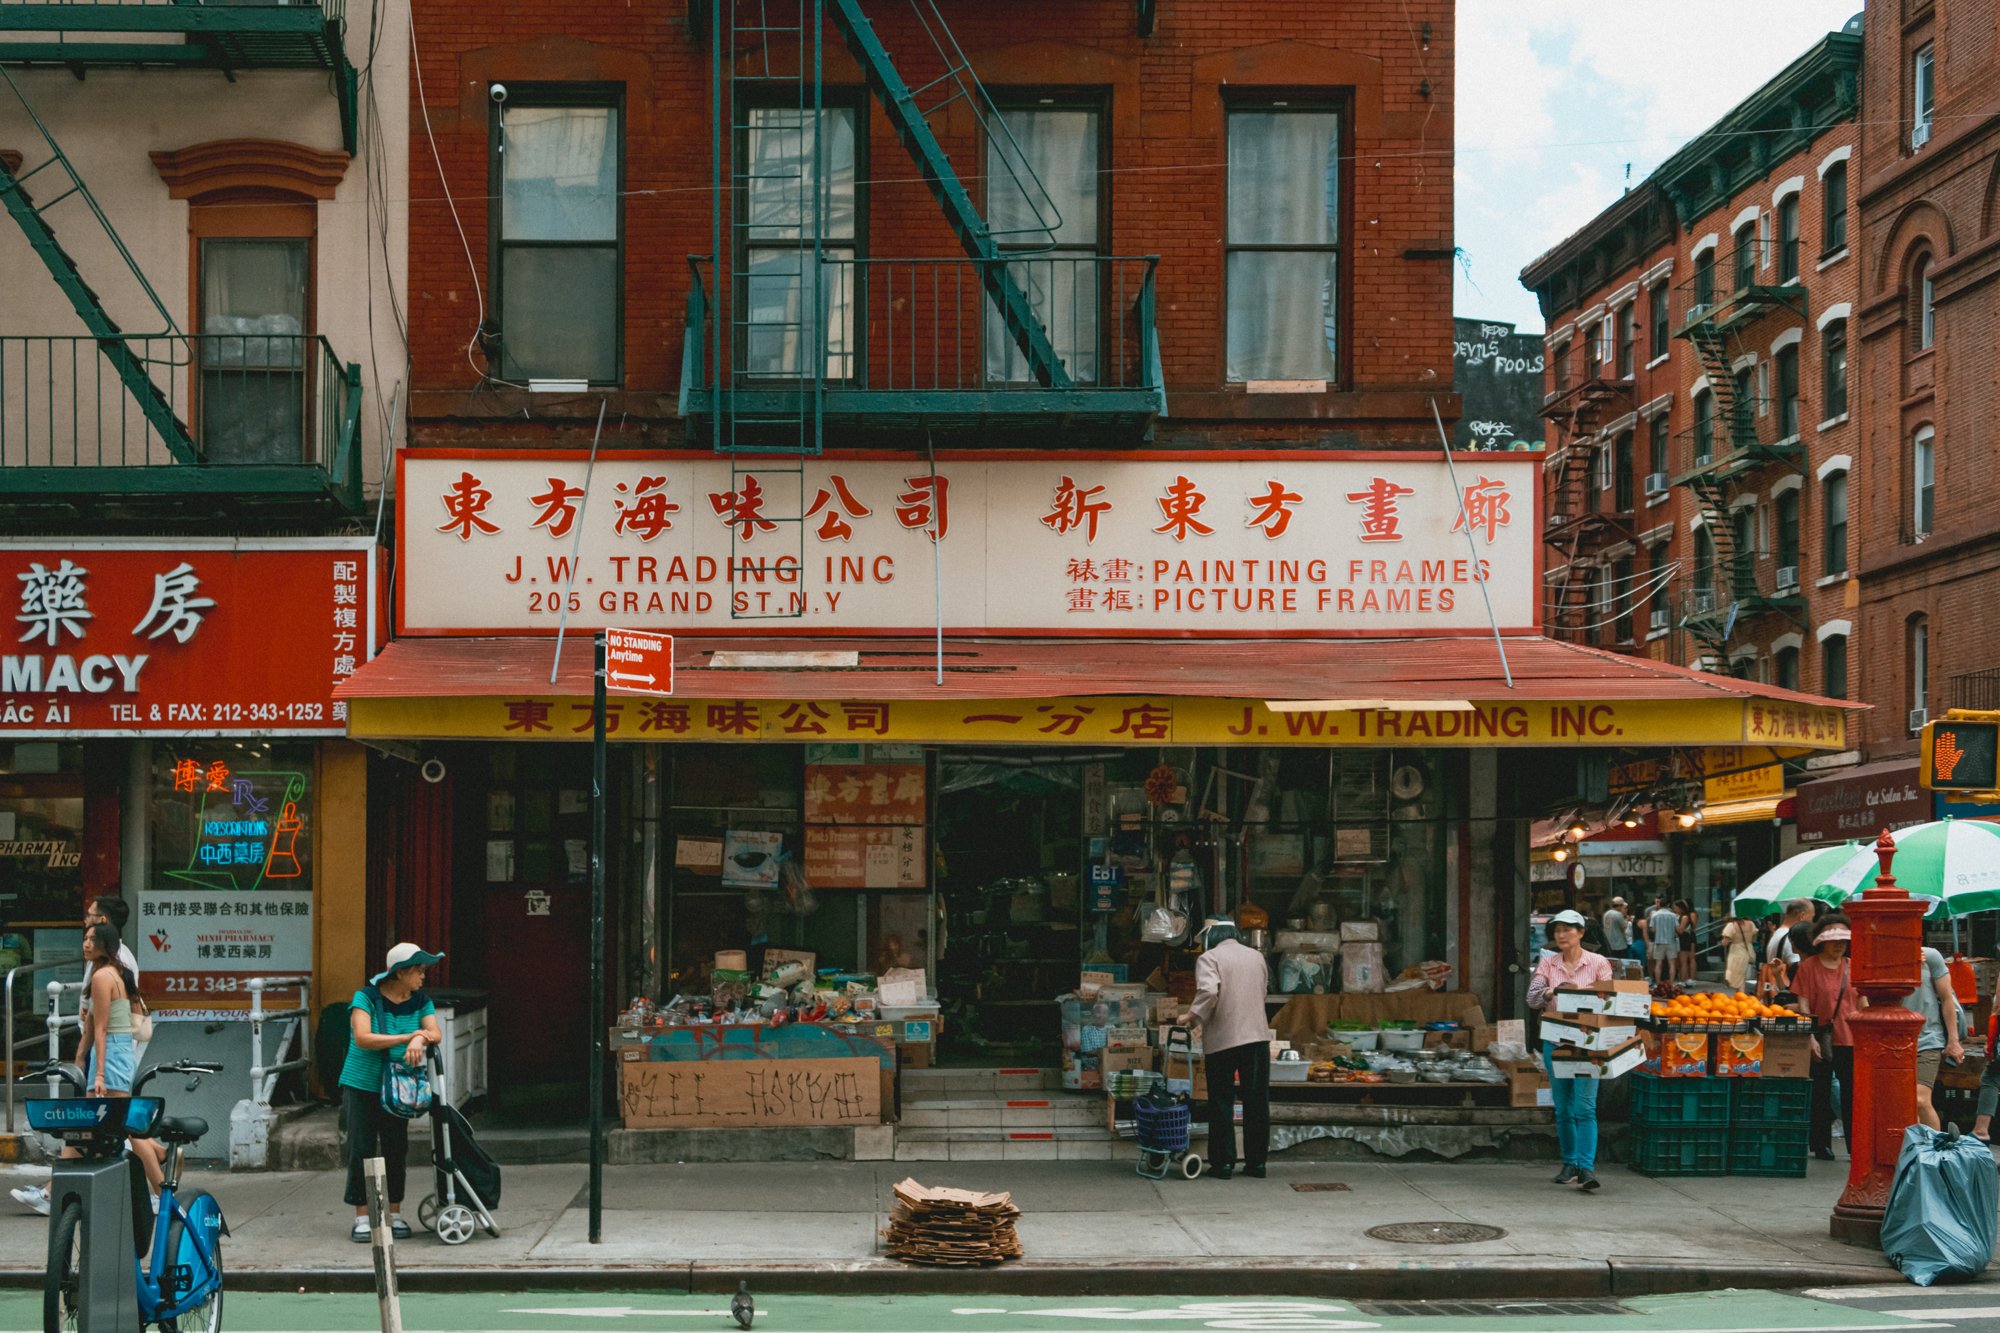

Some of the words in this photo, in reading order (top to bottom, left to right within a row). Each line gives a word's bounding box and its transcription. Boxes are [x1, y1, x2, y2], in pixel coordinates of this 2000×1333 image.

[1495, 356, 1545, 374] FOOLS
[437, 471, 950, 543] 東方海味公司
[1040, 474, 1512, 542] 新東方畫廊
[609, 556, 800, 584] TRADING
[824, 556, 896, 584] INC
[1153, 559, 1327, 584] PAINTING
[1349, 559, 1491, 584] FRAMES
[15, 559, 218, 646] 藥房
[528, 591, 582, 613] 205
[599, 591, 713, 613] GRAND
[1153, 588, 1298, 612] PICTURE
[1318, 588, 1456, 612] FRAMES
[610, 635, 622, 647] NO
[623, 637, 663, 652] STANDING
[610, 648, 644, 663] Anytime
[1, 655, 150, 693] MACY
[0, 698, 35, 724] ÁC
[110, 704, 142, 721] TEL
[149, 704, 161, 721] &
[168, 704, 207, 721] FAX:
[213, 703, 323, 721] 212-343-1252
[502, 700, 892, 735] 東方海味公司
[962, 703, 1172, 738] 一分店
[1355, 706, 1529, 738] TRADING
[1551, 705, 1624, 737] INC.
[1752, 703, 1839, 741] 東方海味公司
[174, 758, 232, 793] 博愛
[0, 841, 64, 854] PHARMAX
[200, 842, 266, 865] 中西藥房
[51, 854, 80, 866] INC
[1092, 865, 1118, 880] EBT
[142, 901, 309, 917] 我們接受聯合和其他保險
[197, 944, 273, 959] 博愛西藥房
[165, 977, 200, 992] 212
[204, 977, 238, 992] 343
[158, 1010, 207, 1018] WATCH
[212, 1010, 251, 1018] YOUR
[44, 1106, 65, 1120] citi
[67, 1107, 95, 1120] bike
